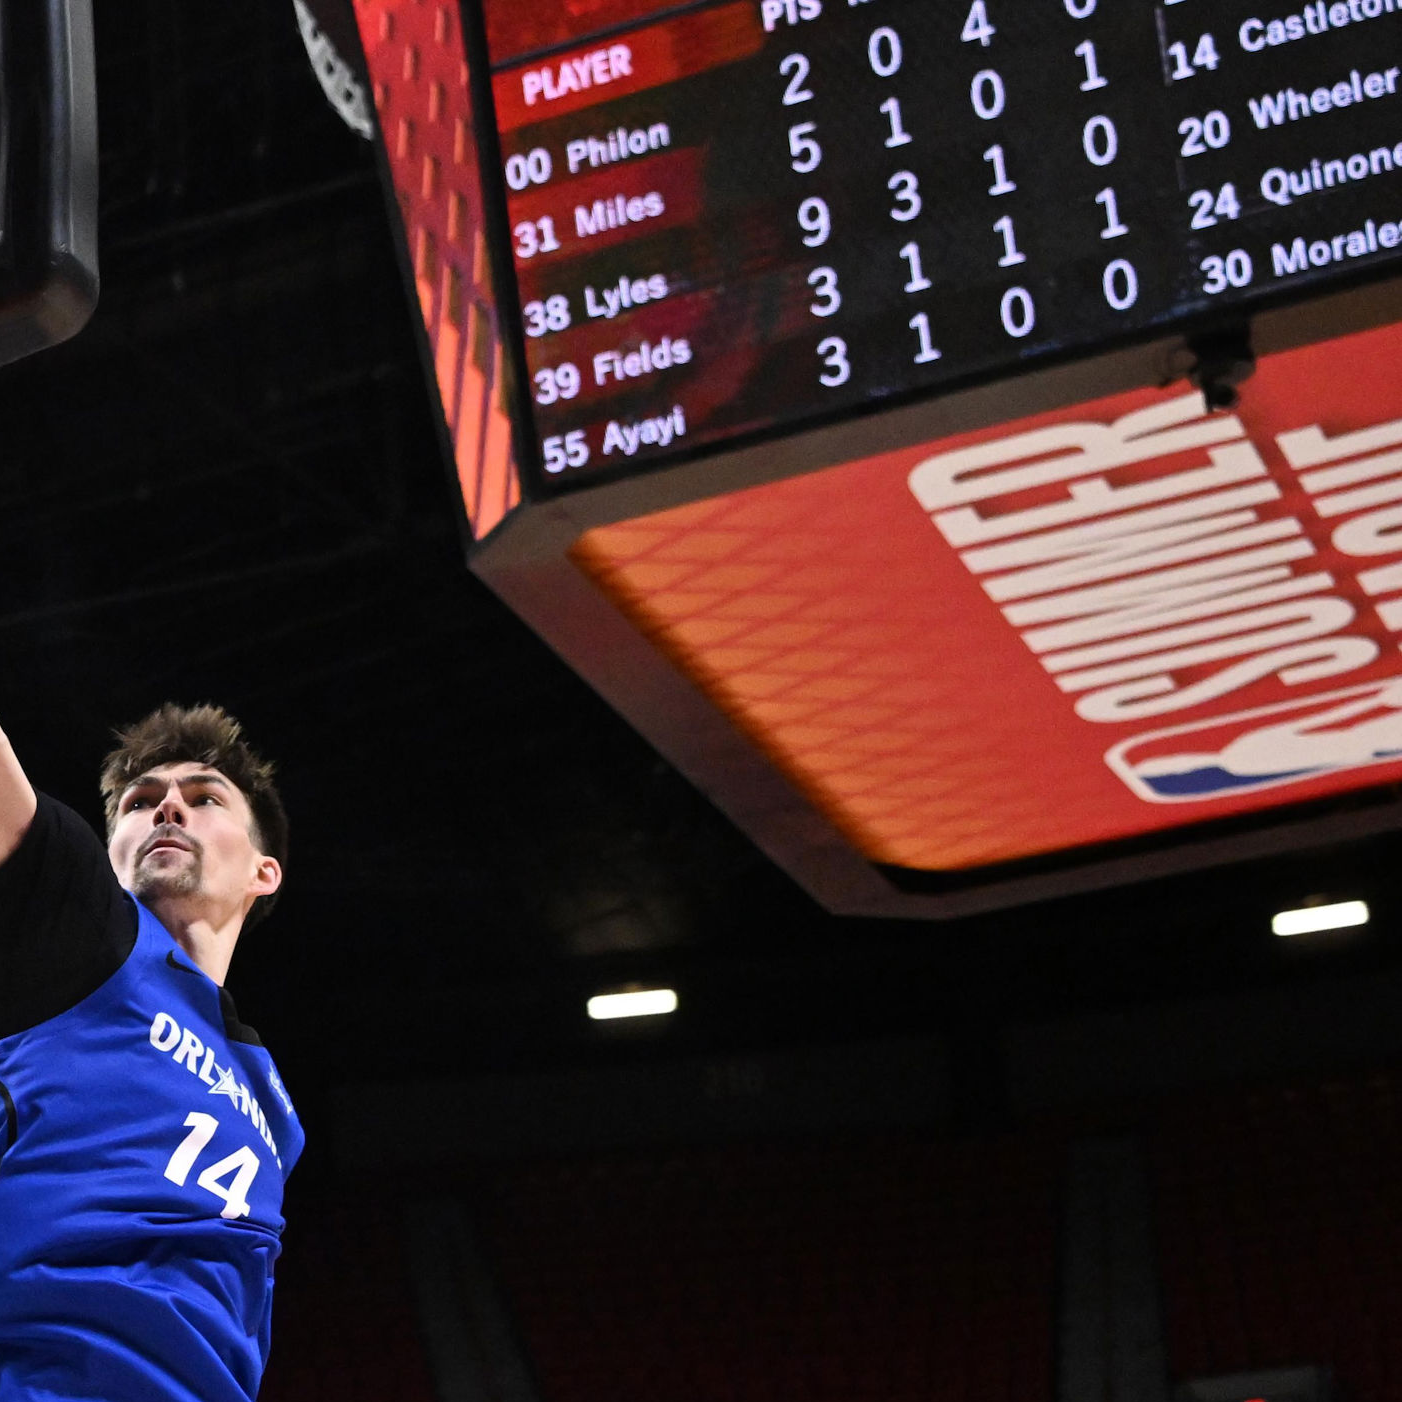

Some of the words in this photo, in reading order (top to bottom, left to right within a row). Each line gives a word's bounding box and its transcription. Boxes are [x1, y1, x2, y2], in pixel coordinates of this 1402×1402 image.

[505, 147, 553, 191] 00
[566, 121, 671, 174] Philon
[779, 53, 814, 106] 2
[867, 25, 903, 78] 0
[960, 0, 996, 47] 4
[522, 44, 633, 105] PLAYER
[1167, 33, 1220, 81] 14
[1177, 110, 1231, 158] 20
[1249, 66, 1401, 130] Wheeler
[513, 216, 561, 259] 31
[575, 191, 665, 238] Miles
[787, 121, 822, 174] 5
[879, 97, 913, 149] 1
[969, 68, 1006, 121] 0
[1074, 39, 1109, 92] 1
[1188, 182, 1242, 231] 24
[522, 294, 571, 339] 38
[584, 273, 669, 320] Lyles
[797, 196, 832, 249] 9
[887, 170, 922, 222] 3
[982, 143, 1018, 196] 1
[1082, 115, 1118, 166] 0
[533, 362, 581, 406] 39
[593, 335, 693, 388] Fields
[807, 265, 842, 318] 3
[899, 242, 933, 294] 1
[992, 215, 1028, 268] 1
[1094, 187, 1130, 241] 1
[1200, 249, 1254, 295] 30
[1270, 218, 1402, 278] Morale
[542, 430, 591, 475] 55
[602, 404, 687, 457] Ayayi
[816, 335, 852, 388] 3
[908, 312, 943, 364] 1
[1000, 285, 1037, 338] 0
[1102, 258, 1139, 311] 0
[907, 390, 1379, 723] SUMMER
[163, 1111, 260, 1220] 14
